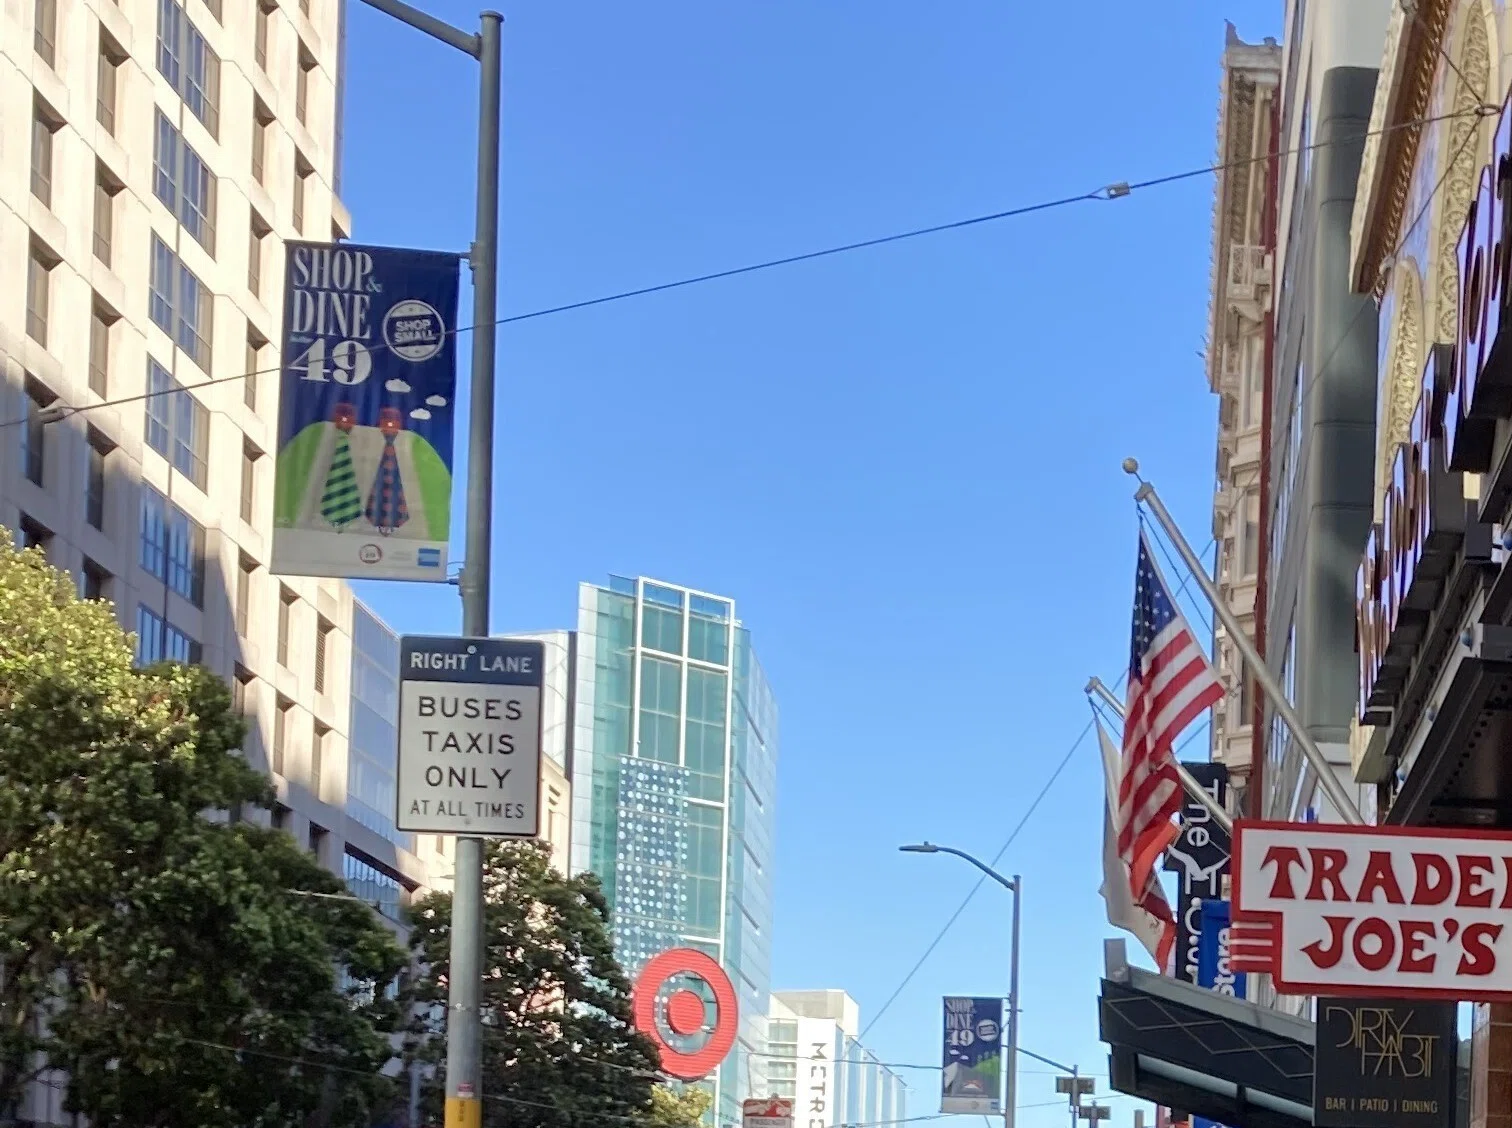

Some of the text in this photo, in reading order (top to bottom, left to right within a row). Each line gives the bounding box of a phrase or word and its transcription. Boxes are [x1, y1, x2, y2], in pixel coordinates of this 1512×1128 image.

[293, 247, 373, 291] SHOP
[292, 289, 371, 339] DINE
[396, 319, 431, 331] SHOP
[395, 330, 437, 342] SMALL
[288, 338, 372, 385] 49
[411, 652, 533, 673] RIGHT LANE
[419, 696, 522, 720] BUSES
[422, 731, 515, 755] TAXIS
[425, 766, 512, 789] ONLY
[410, 800, 525, 819] AT ALL TIMES
[1300, 915, 1504, 976] JOE'S
[946, 1030, 974, 1046] 49
[1326, 1006, 1414, 1048] DIRTY
[1325, 1097, 1438, 1113] BAR PATIO DINING
